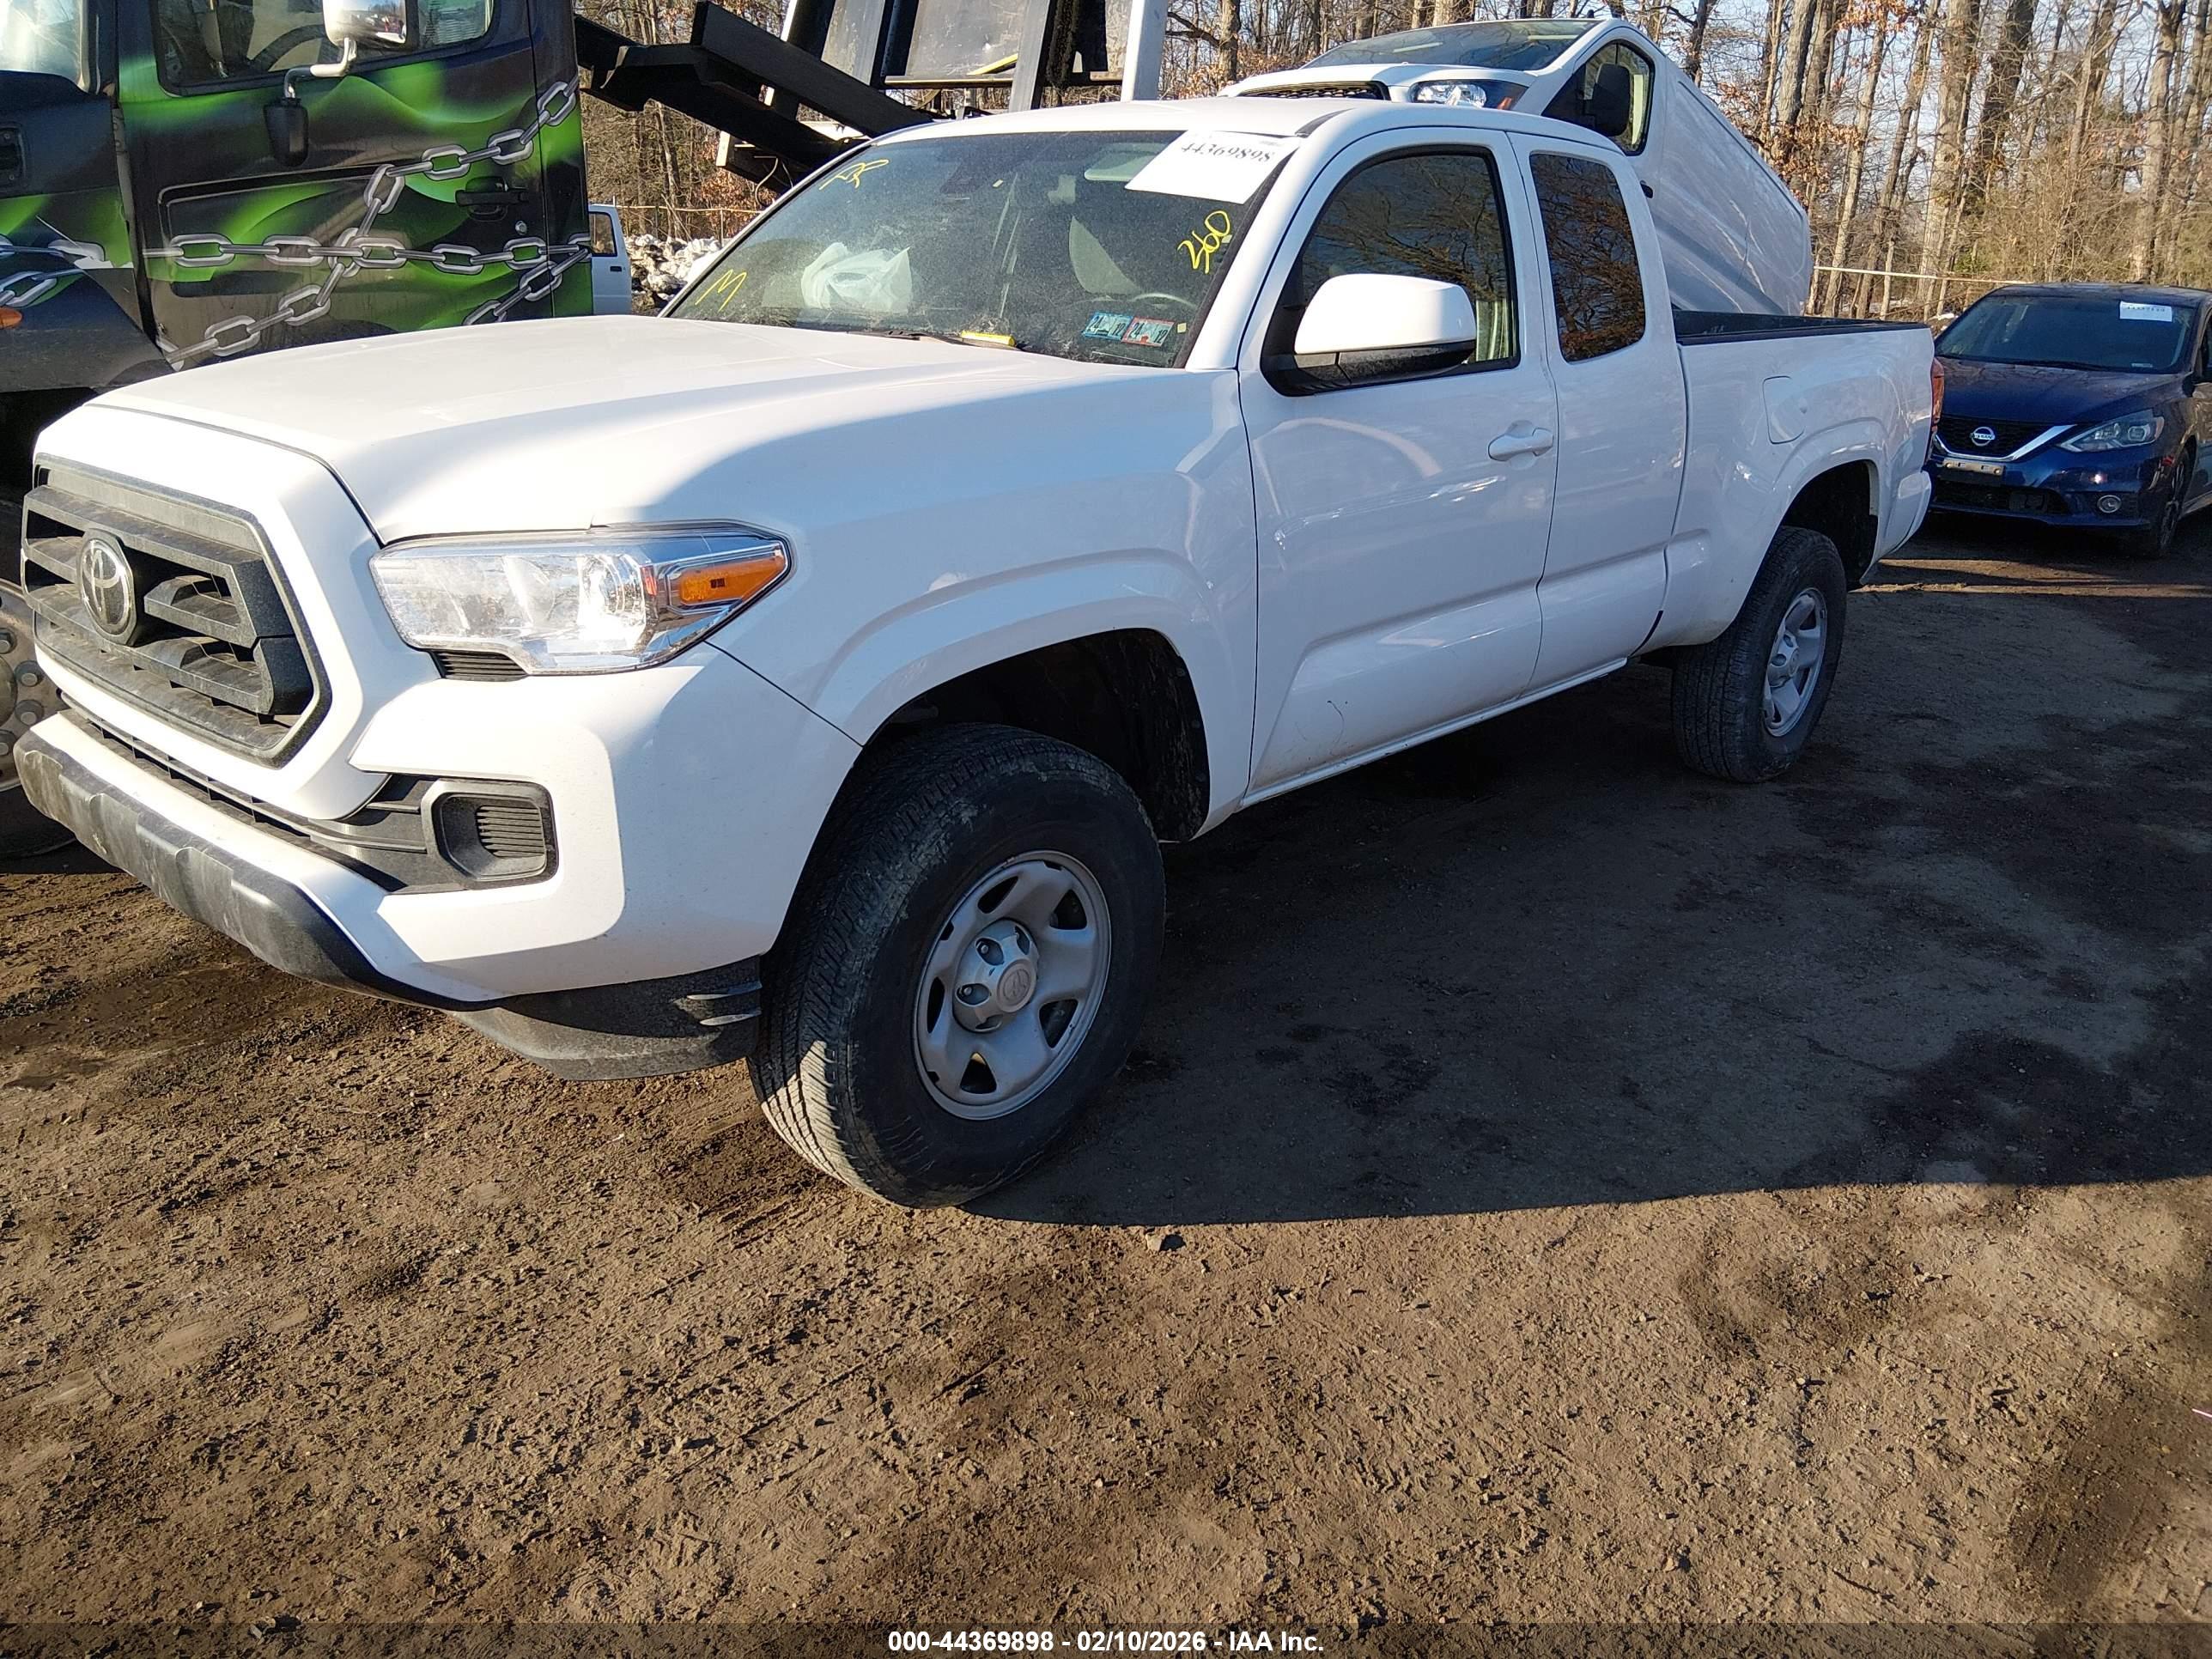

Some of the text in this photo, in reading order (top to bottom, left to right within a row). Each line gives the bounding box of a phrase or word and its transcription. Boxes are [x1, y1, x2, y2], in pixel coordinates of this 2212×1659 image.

[1181, 142, 1275, 163] 44369898
[1128, 321, 1168, 344] 24 12
